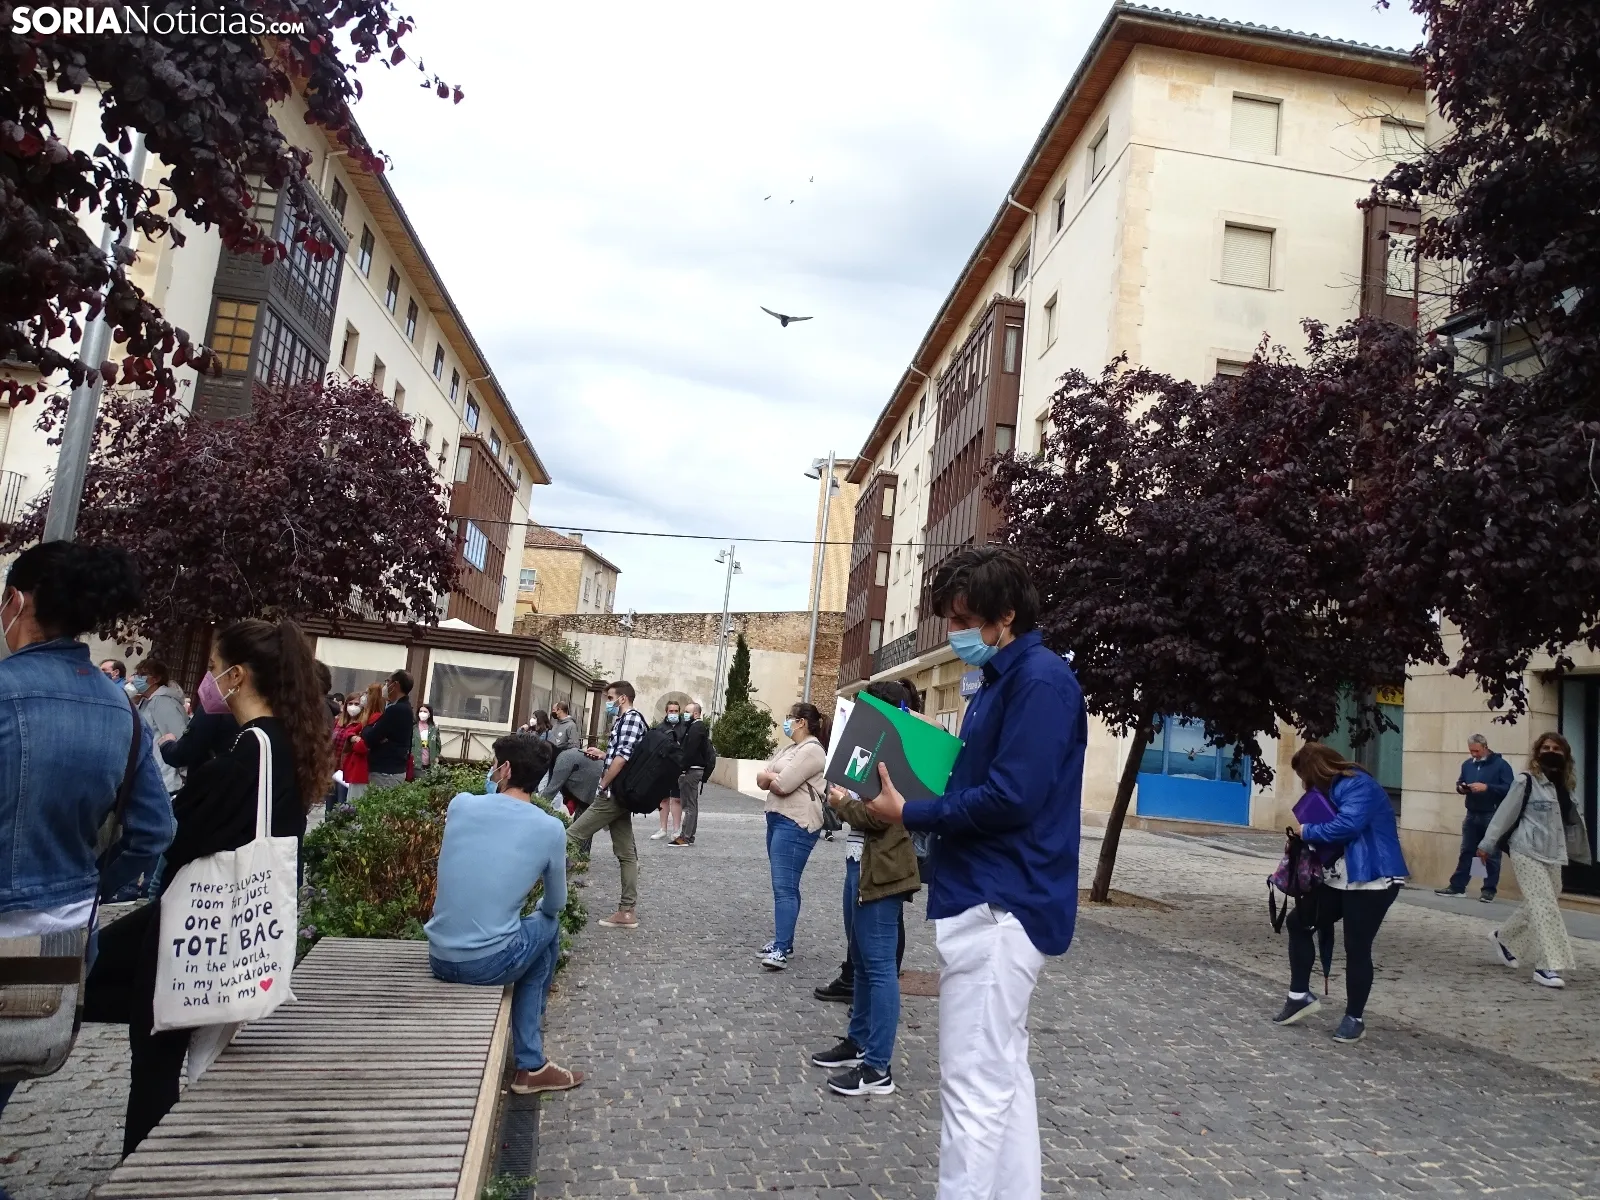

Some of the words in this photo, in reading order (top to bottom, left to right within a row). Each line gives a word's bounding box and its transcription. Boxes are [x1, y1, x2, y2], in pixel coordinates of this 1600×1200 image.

[190, 882, 235, 894] There's
[191, 898, 224, 909] room
[245, 883, 269, 905] just
[185, 915, 221, 931] one
[231, 901, 273, 928] more
[173, 933, 228, 957] TOTE
[240, 919, 284, 950] BAG
[185, 962, 198, 973] in
[206, 960, 226, 972] the
[232, 947, 271, 968] world,
[172, 979, 185, 991] in
[193, 978, 213, 991] my
[220, 961, 282, 988] wardrobe,
[183, 993, 210, 1007] and
[217, 991, 230, 1003] in
[238, 986, 256, 999] my
